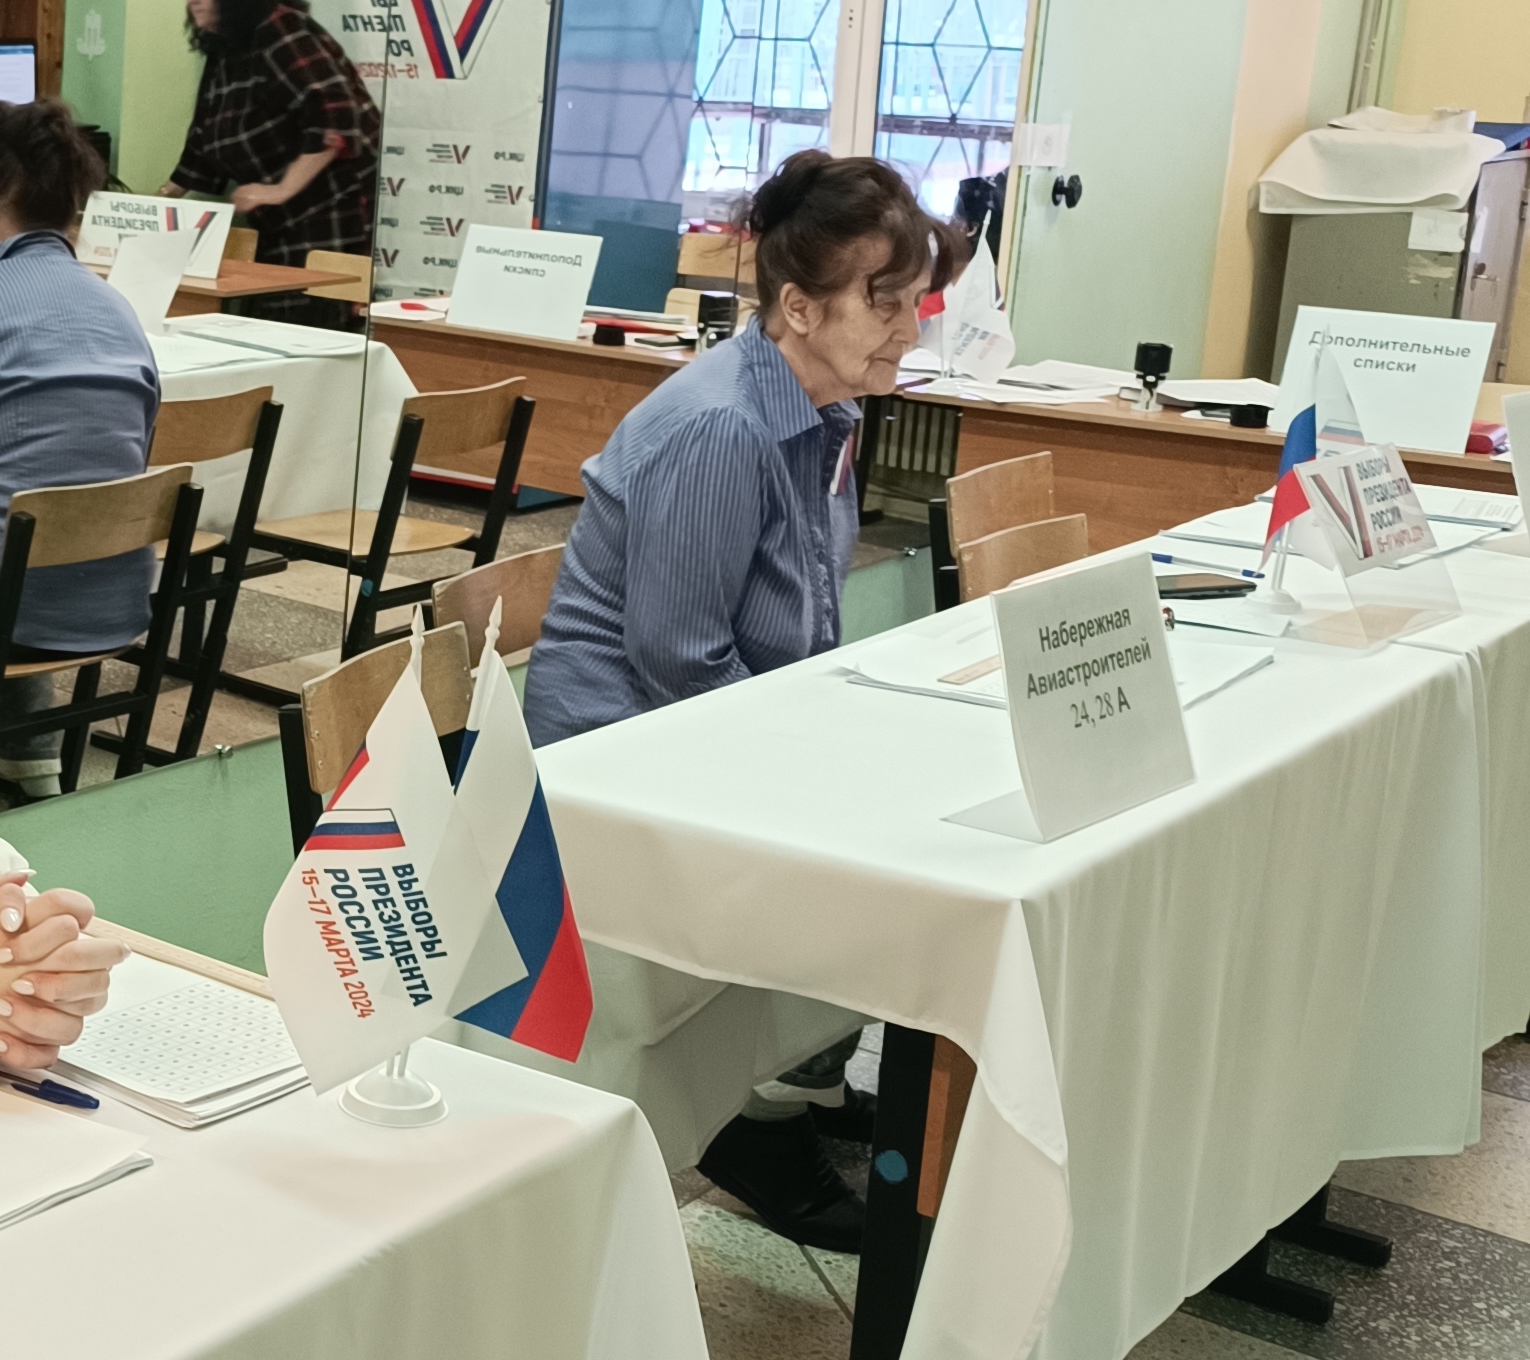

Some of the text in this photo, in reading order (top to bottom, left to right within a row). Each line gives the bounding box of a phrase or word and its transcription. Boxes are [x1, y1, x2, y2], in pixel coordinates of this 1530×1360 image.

[1308, 331, 1471, 358] Дополнительные
[1353, 357, 1417, 373] списки
[1038, 608, 1132, 652] Набережная
[1027, 636, 1152, 699] Авиастроителей
[1070, 686, 1131, 728] 24, 28 А
[323, 868, 385, 961] РОССИИ
[358, 867, 433, 1007] ПРЕЗИДЕНТА
[392, 863, 448, 959] ВЫБОРЫ
[315, 920, 359, 978] МАРТА
[343, 981, 375, 1018] 2024
